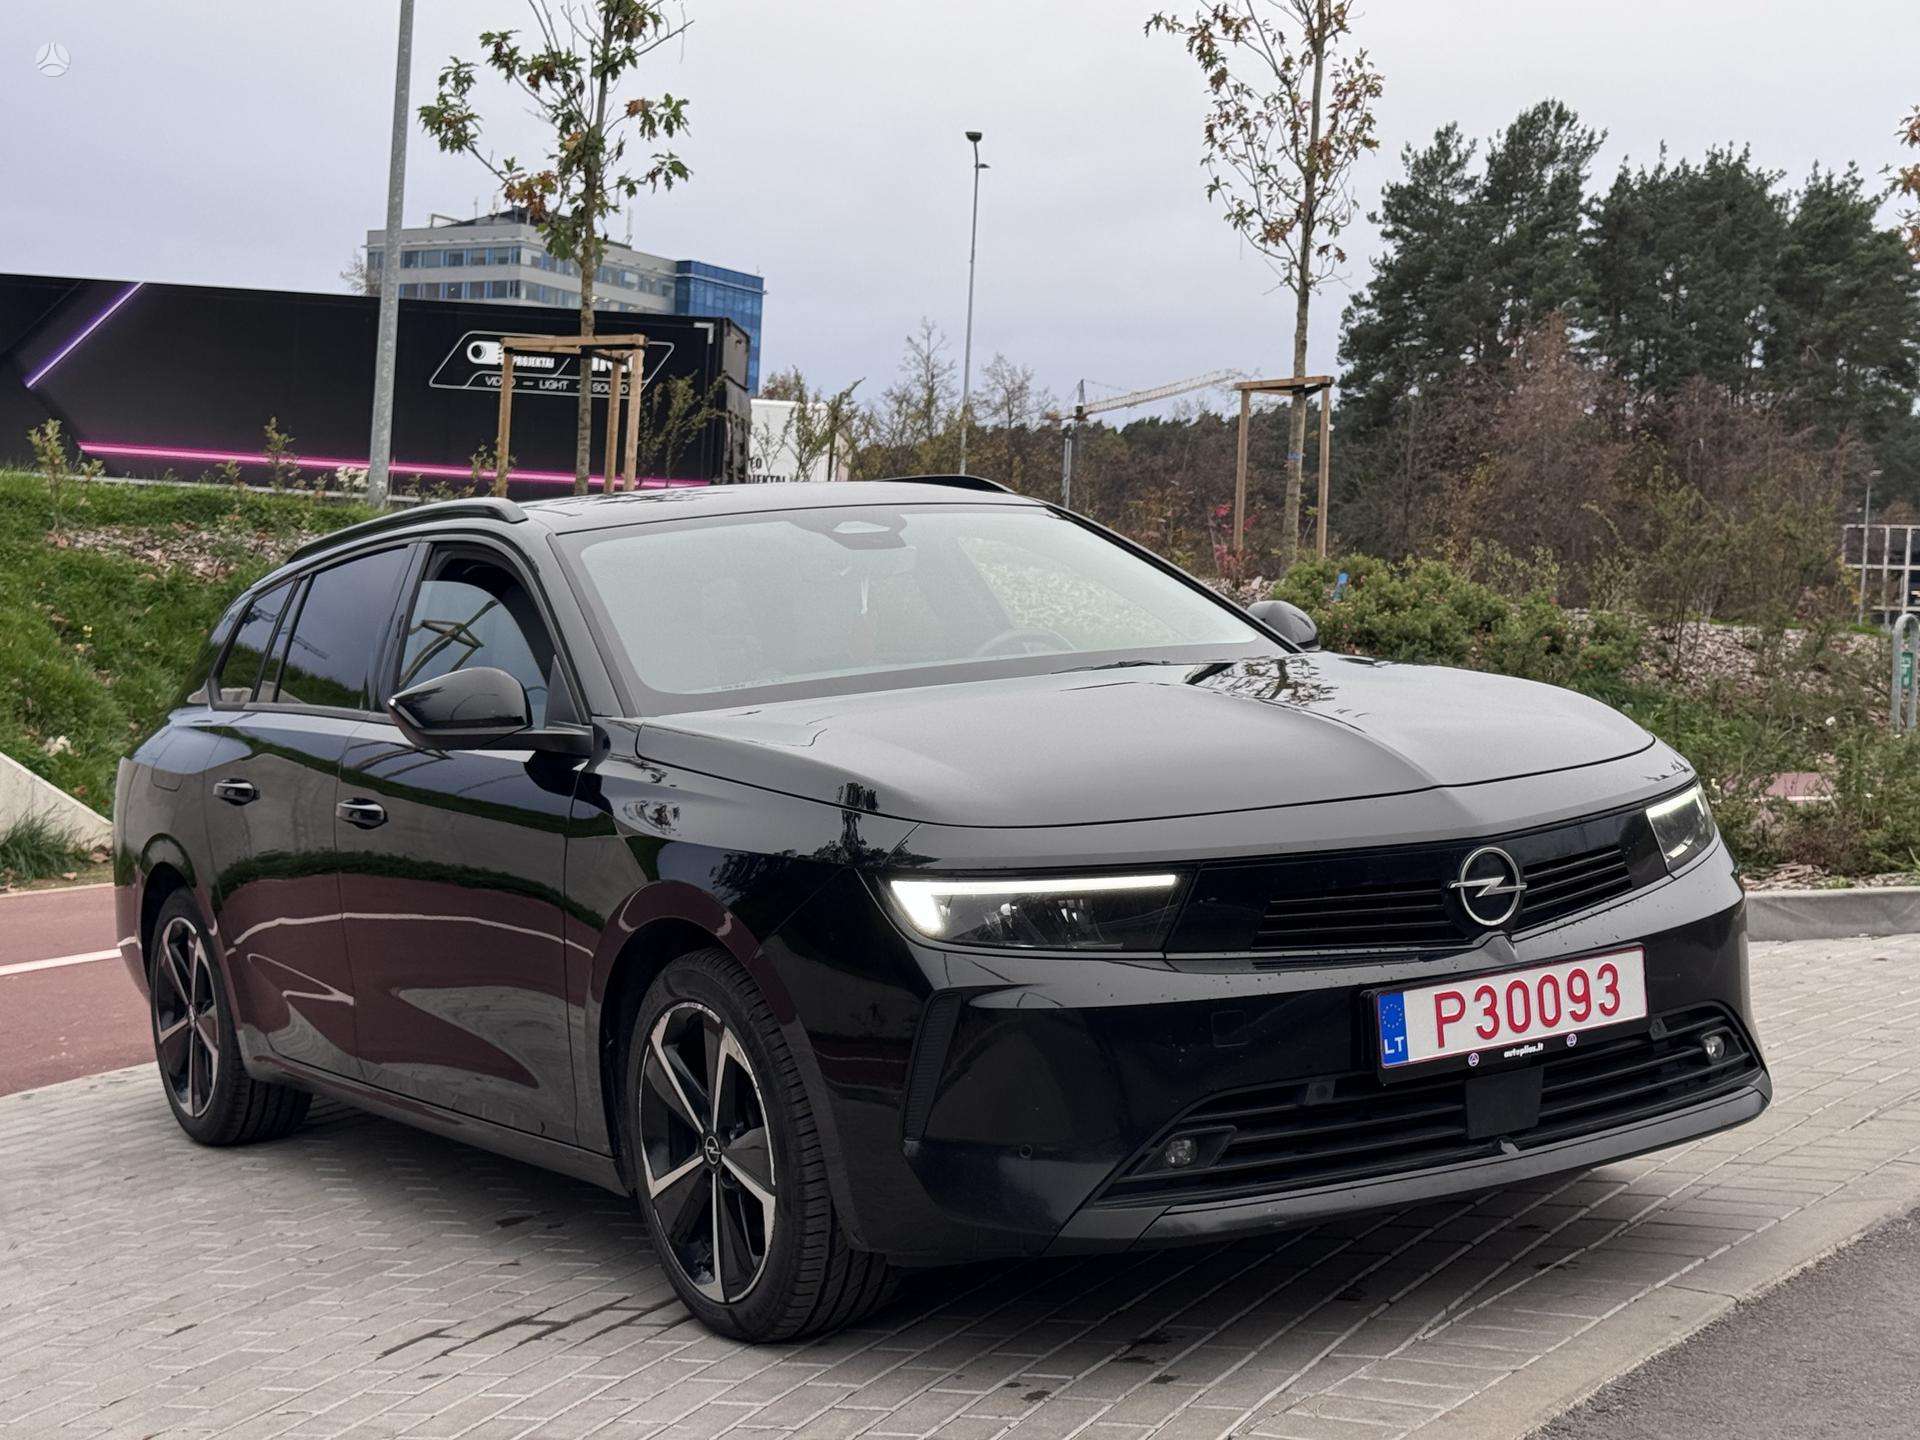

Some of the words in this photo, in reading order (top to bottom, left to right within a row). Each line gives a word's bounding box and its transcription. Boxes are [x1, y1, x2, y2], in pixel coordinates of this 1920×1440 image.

[485, 375, 516, 387] VIDO
[539, 379, 569, 390] LIGHT
[1433, 962, 1621, 1048] P30093
[1384, 1036, 1404, 1055] LT
